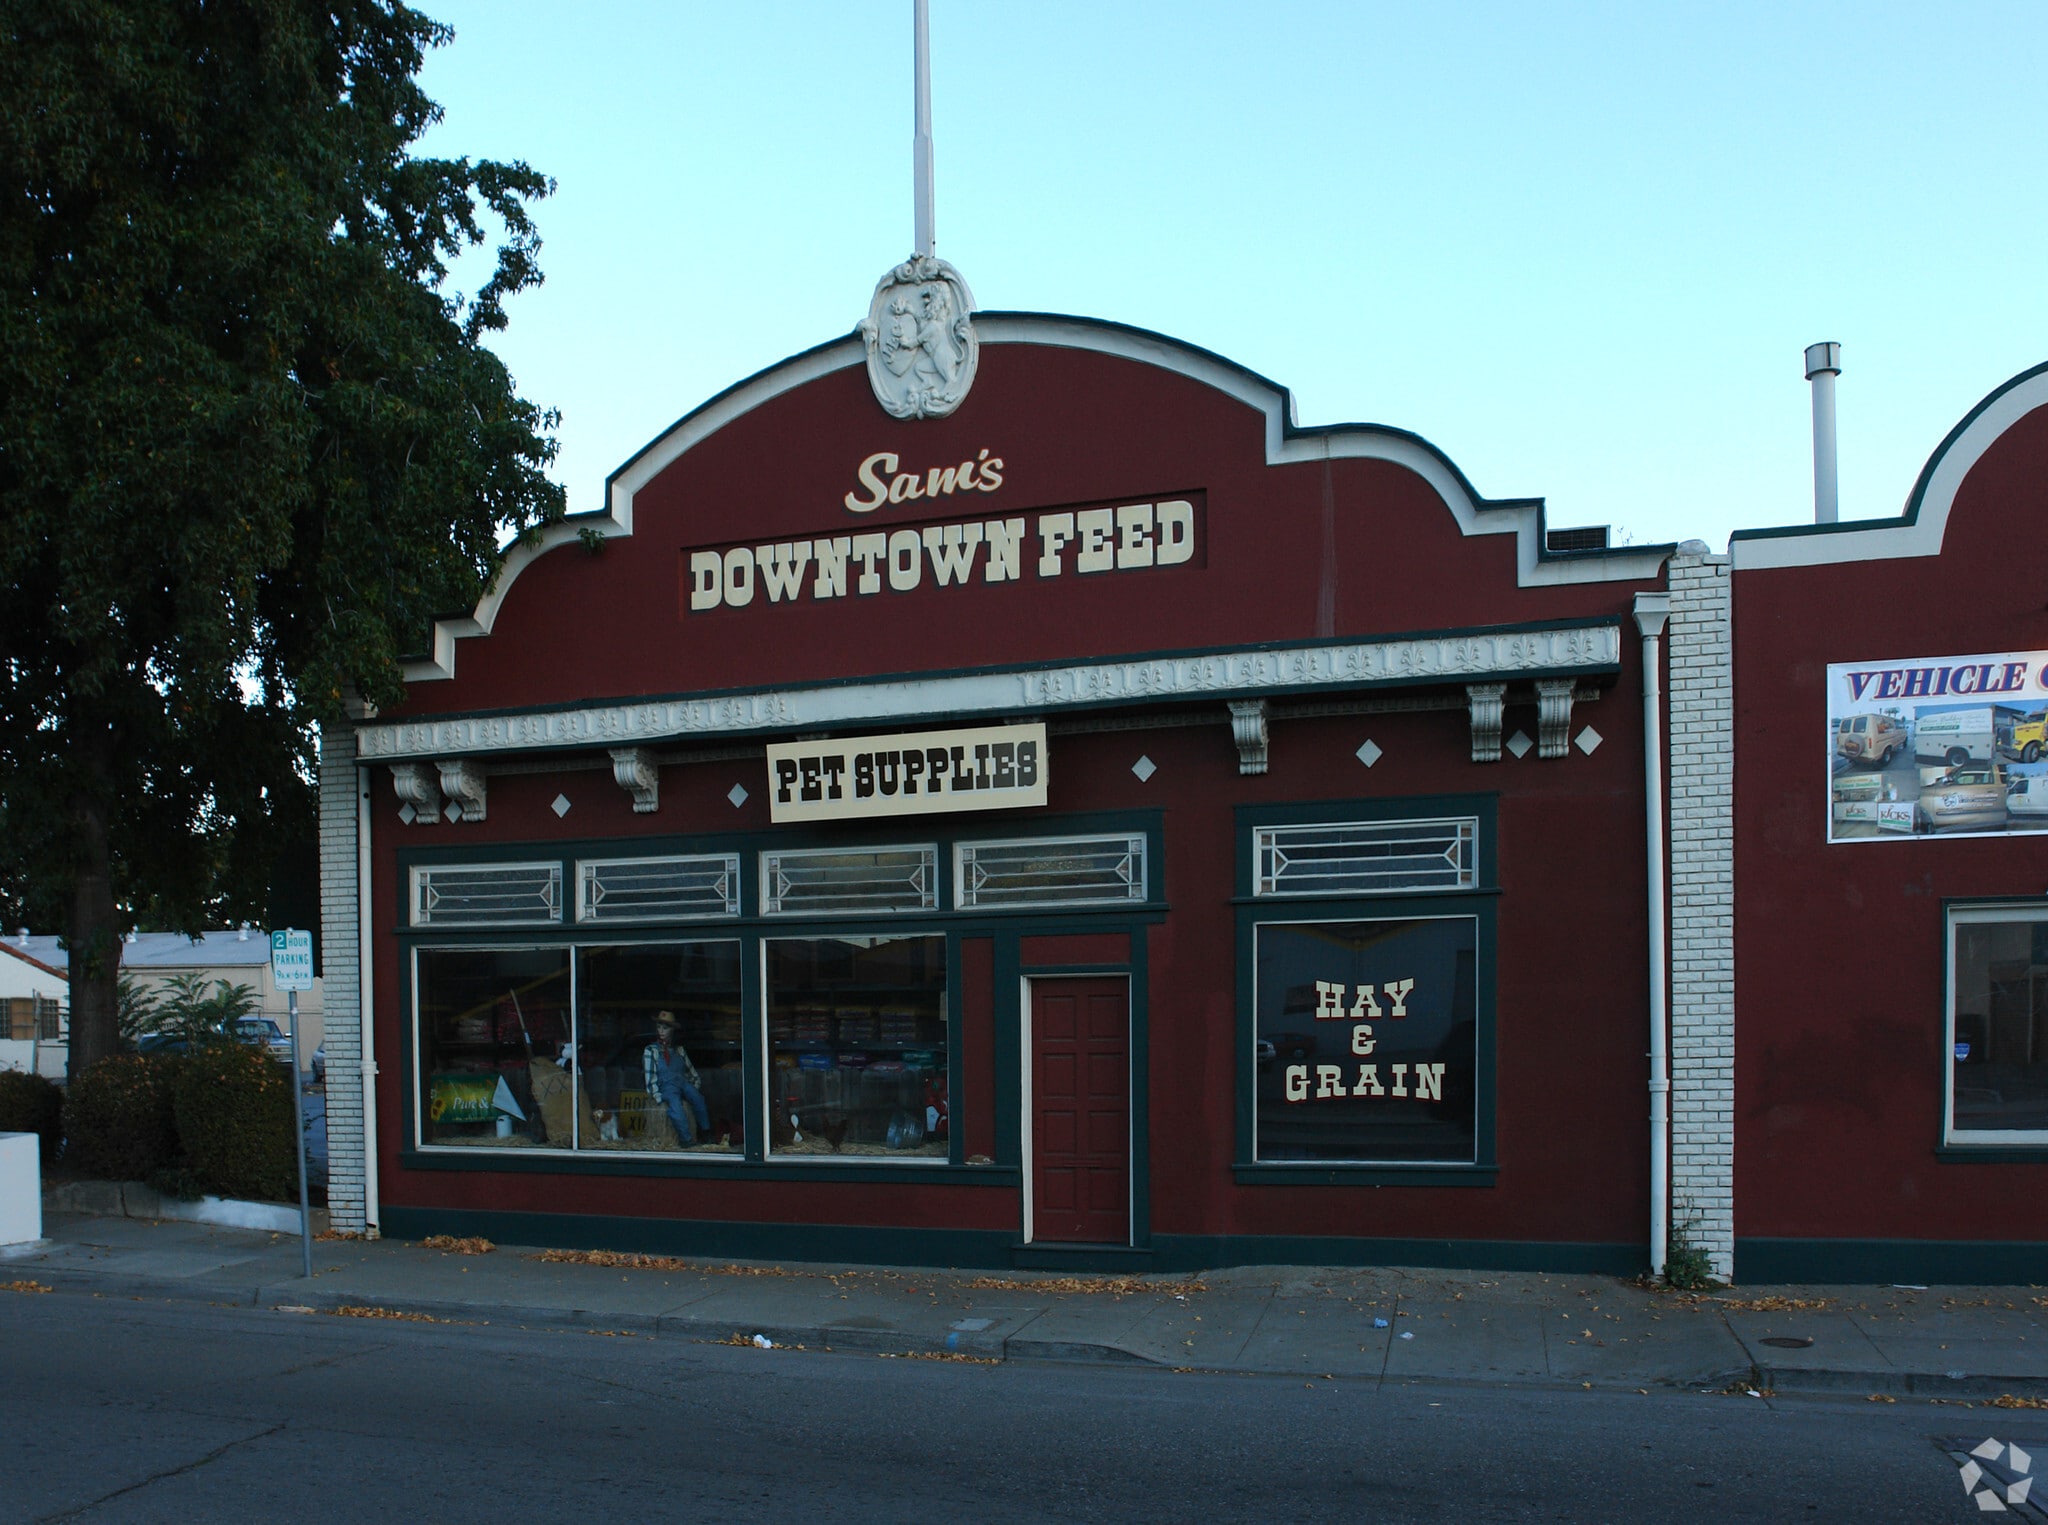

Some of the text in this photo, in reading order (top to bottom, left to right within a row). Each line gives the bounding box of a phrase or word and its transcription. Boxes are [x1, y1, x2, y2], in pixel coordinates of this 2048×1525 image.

[844, 449, 1004, 513] Sam's
[690, 500, 1196, 611] DOWNTOWN FEED
[1847, 662, 2028, 700] VEHICLE
[776, 740, 1038, 804] PET SUPPLIES
[275, 934, 308, 948] 2 HOUR
[275, 953, 309, 965] PARKING
[1315, 978, 1414, 1018] HAY
[1352, 1024, 1377, 1055] &
[1285, 1063, 1446, 1101] GRAIN
